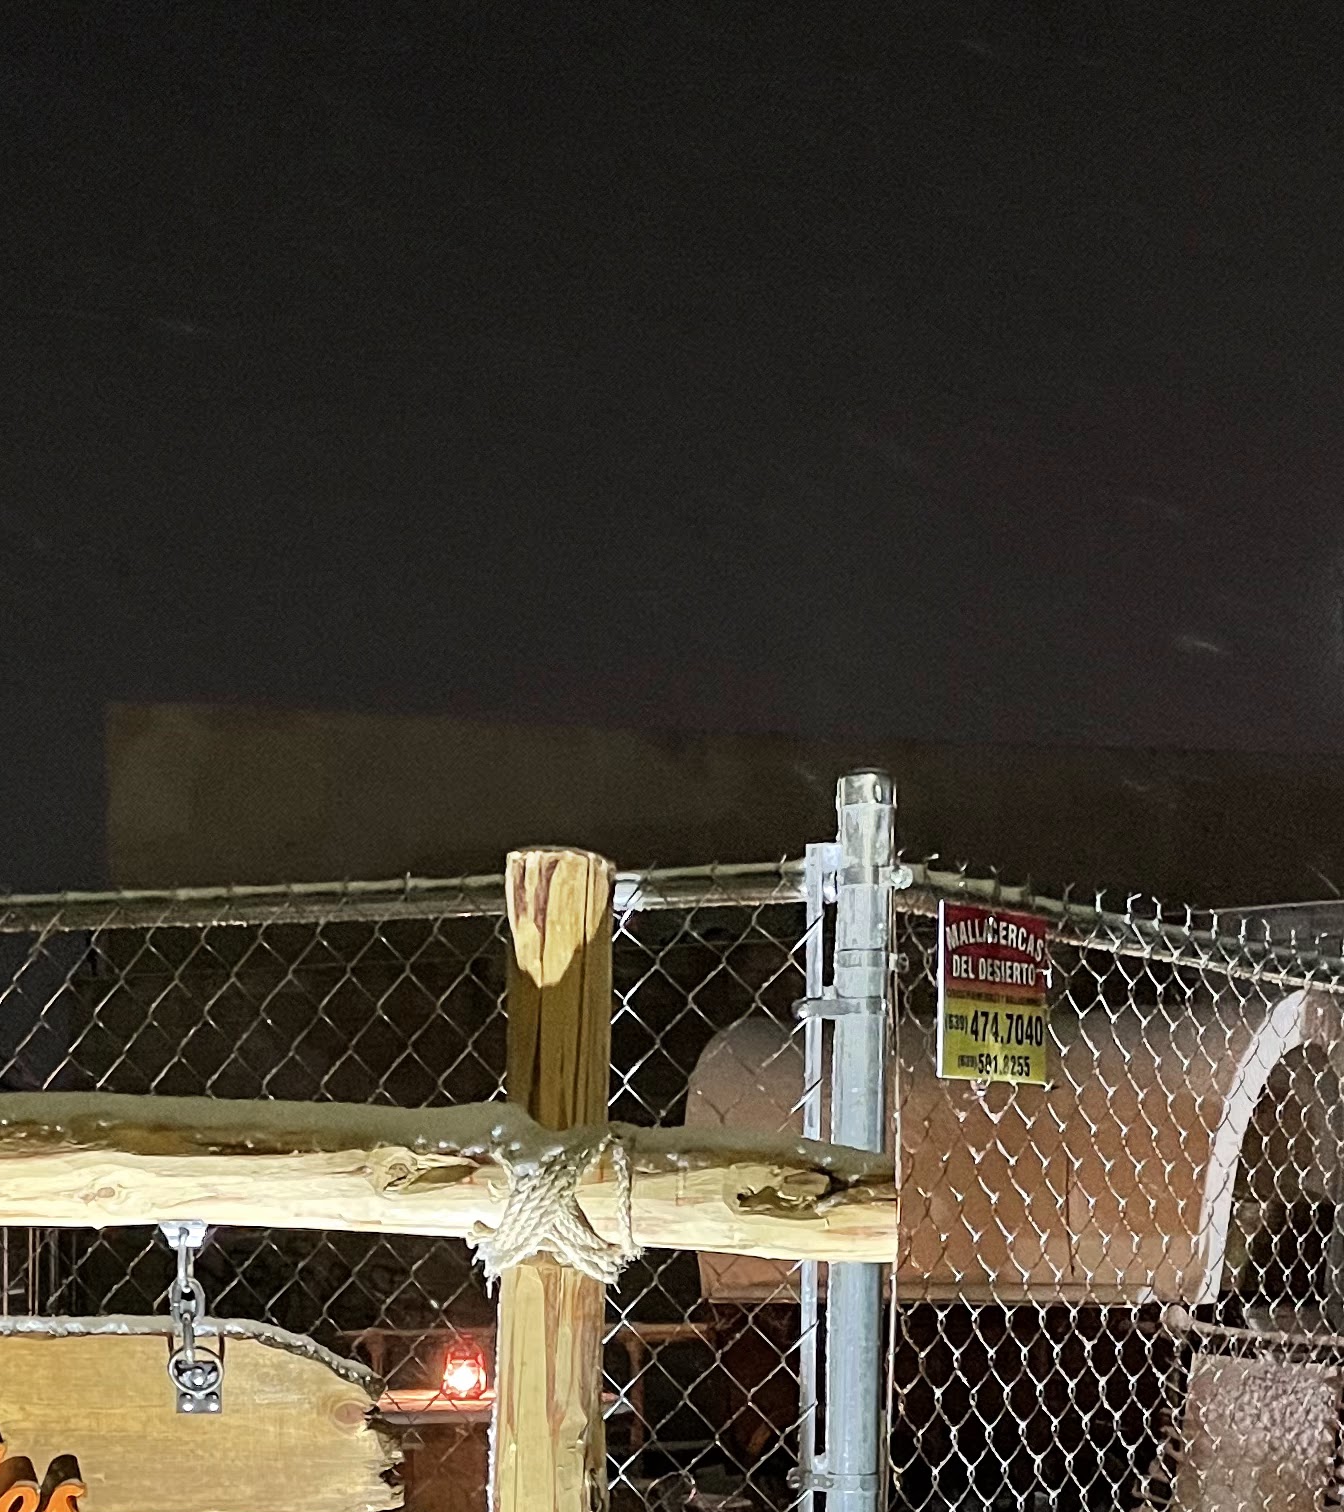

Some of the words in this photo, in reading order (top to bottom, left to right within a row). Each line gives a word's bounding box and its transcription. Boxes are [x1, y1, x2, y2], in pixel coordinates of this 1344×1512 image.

[952, 954, 975, 979] DEL
[979, 957, 1036, 986] DESIERTO
[970, 1009, 1043, 1047] 474.7040
